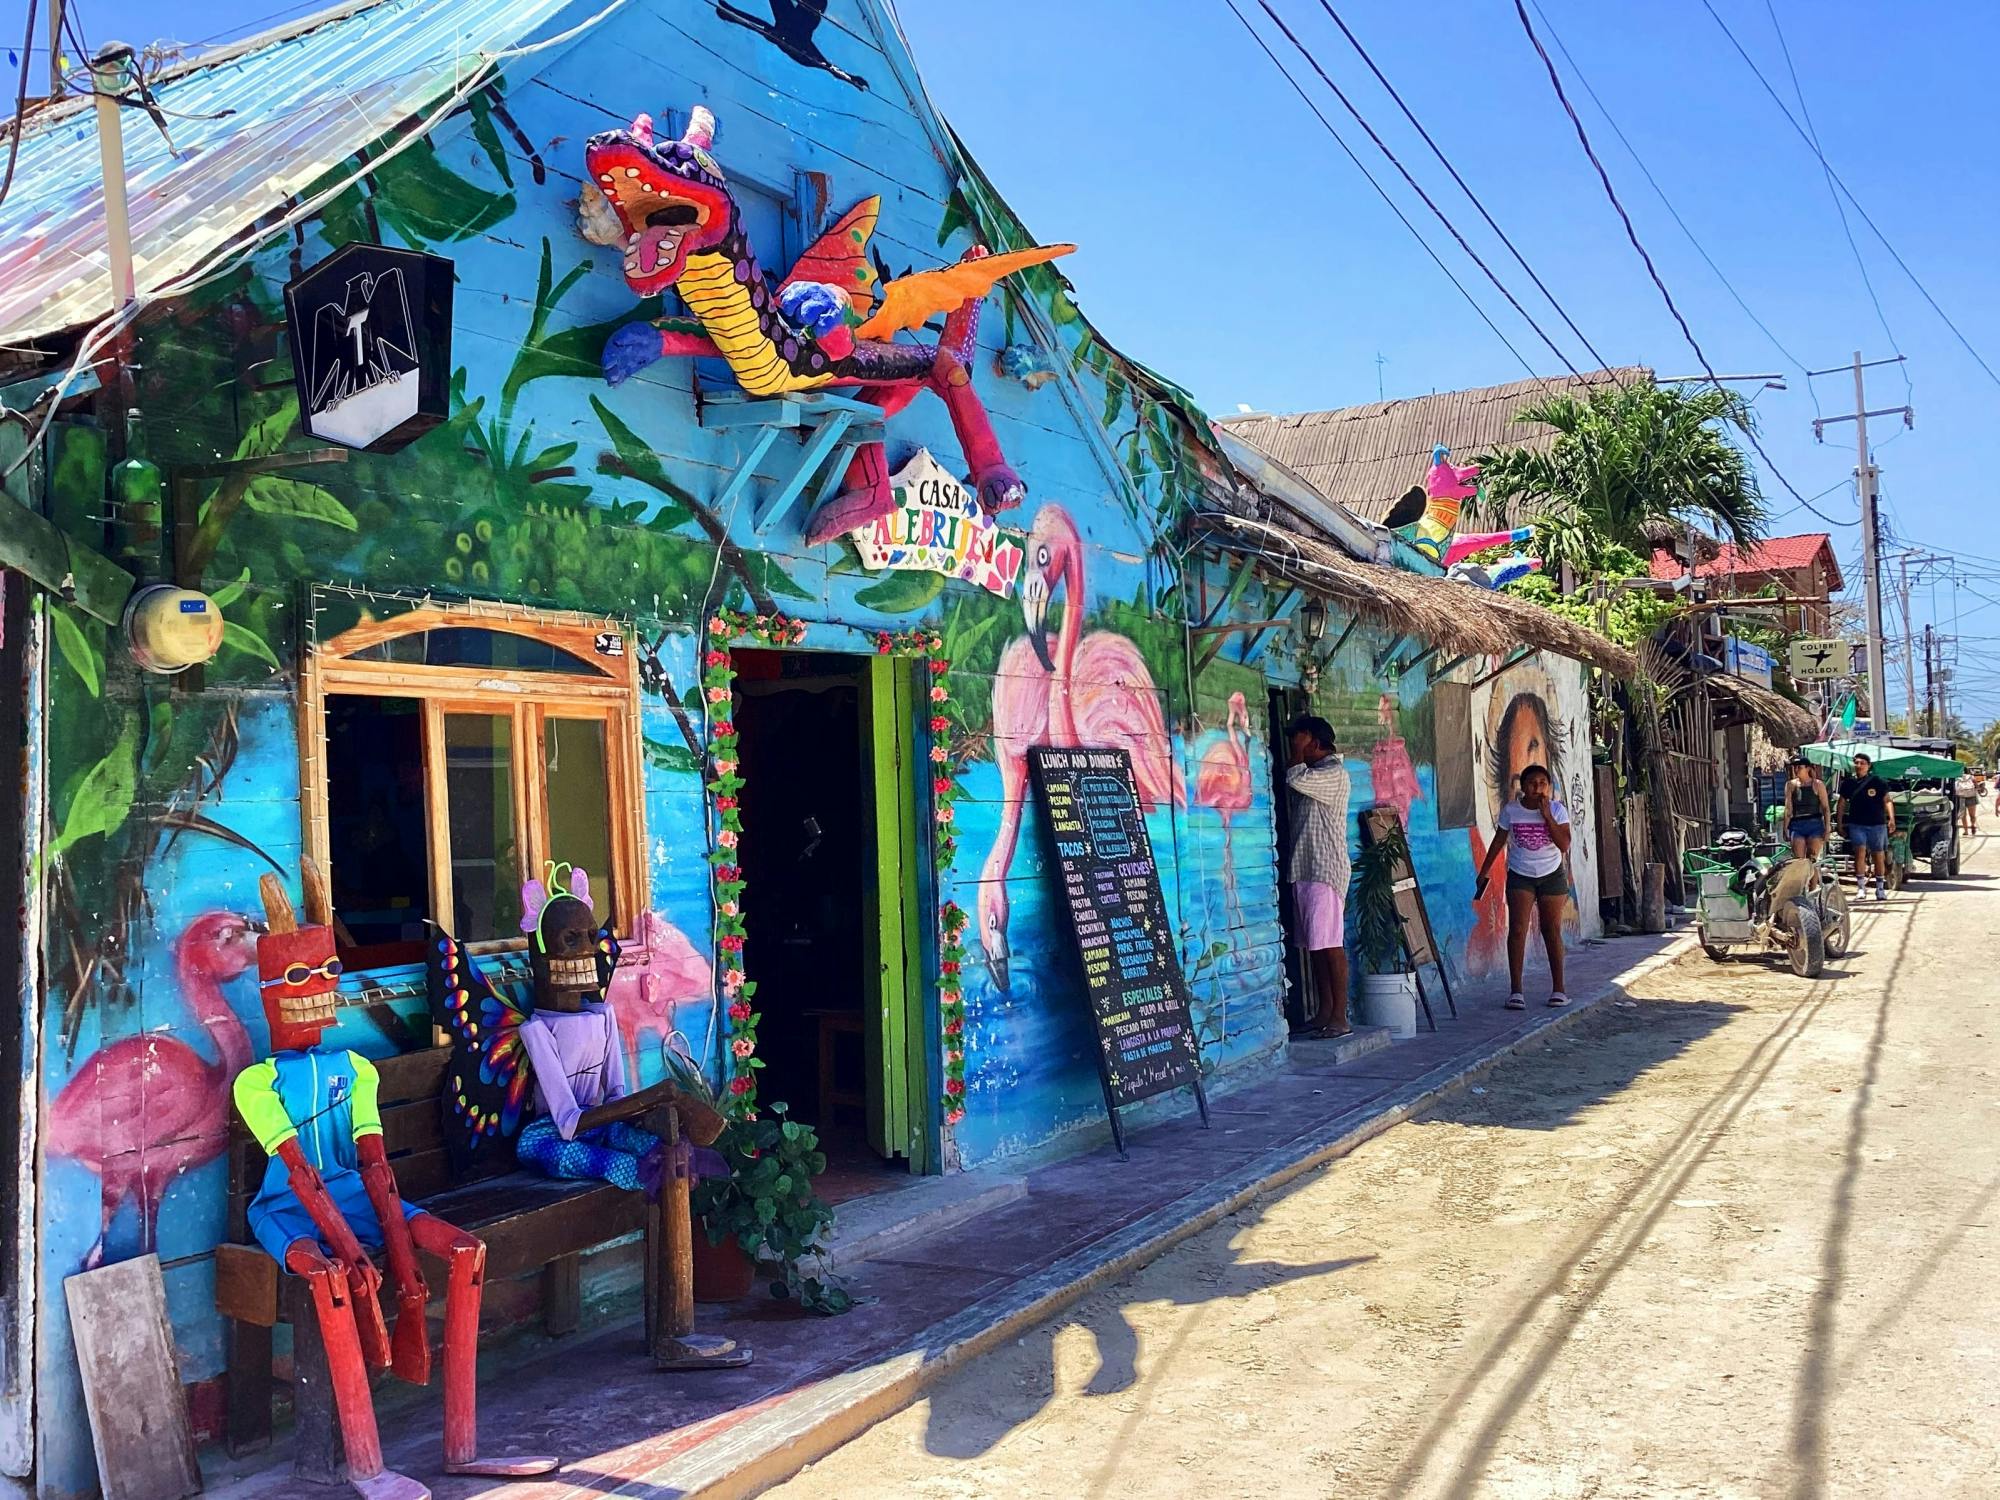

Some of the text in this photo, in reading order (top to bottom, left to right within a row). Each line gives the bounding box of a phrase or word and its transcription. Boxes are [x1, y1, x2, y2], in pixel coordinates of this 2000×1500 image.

[919, 479, 960, 509] CASA
[873, 507, 984, 565] ALEBRIJE
[1040, 753, 1117, 769] LUNCH AND DINNER
[1050, 796, 1072, 806] PESCADO
[1052, 808, 1069, 818] PULPO
[1055, 821, 1081, 831] LANGOSTA
[1057, 842, 1085, 857] TACOS
[1063, 861, 1074, 871] RES
[1118, 861, 1150, 877] CEVICHES
[1067, 873, 1084, 883] ASADA
[1069, 885, 1085, 895] POLLO
[1127, 890, 1148, 901] PESCADO
[1072, 898, 1092, 909] PASTOR
[1129, 903, 1145, 914] PULPO
[1075, 910, 1098, 922] CHORIZO
[1110, 916, 1133, 929] NACHOS
[1078, 922, 1106, 935] COCHINITA
[1113, 928, 1146, 942] GUACAMOLE
[1116, 940, 1154, 954] PAPAS FRITAS
[1119, 952, 1154, 967] QUESADILLAS
[1087, 961, 1110, 974] PESCADO
[1122, 965, 1148, 979] BURRITOS
[1090, 976, 1107, 988] PULPO
[1122, 985, 1163, 1007] ESPECIALES
[1140, 1000, 1180, 1016] PULPO AL GRILL
[1103, 1011, 1131, 1027] MARISCADA
[1116, 1018, 1156, 1036] PESCADO FRITO
[1120, 1033, 1147, 1051] LANGOSTA
[1147, 1032, 1152, 1042] A
[1153, 1029, 1161, 1040] LA
[1123, 1040, 1173, 1062] PASTA DE MARISCOS
